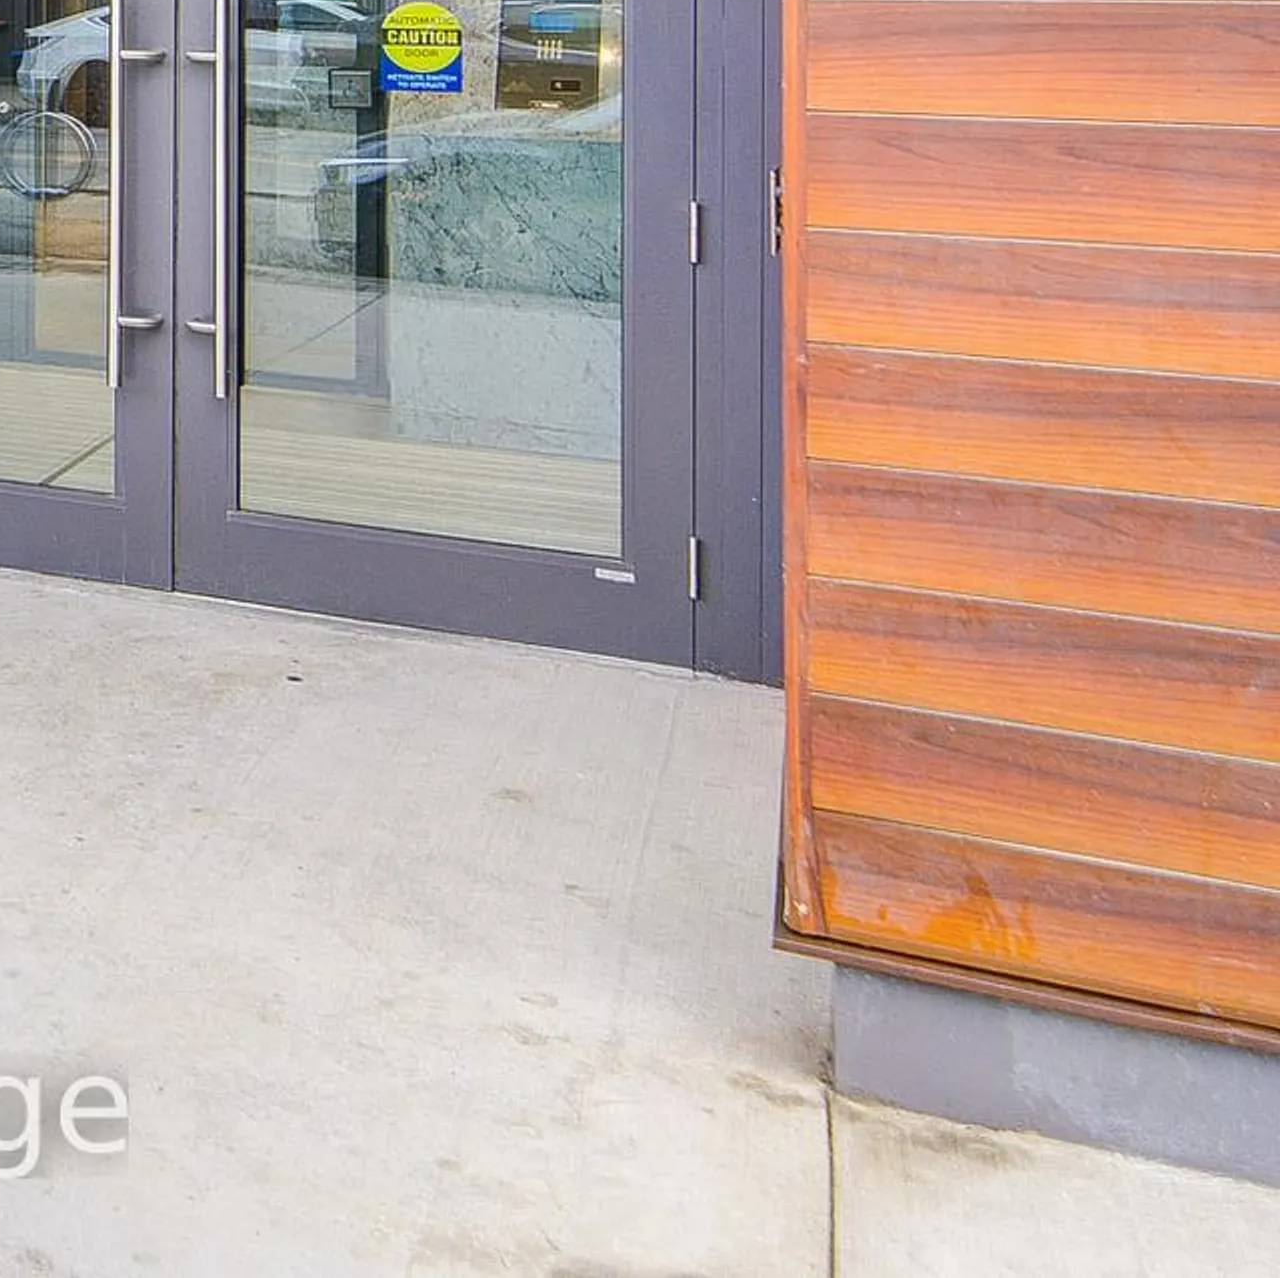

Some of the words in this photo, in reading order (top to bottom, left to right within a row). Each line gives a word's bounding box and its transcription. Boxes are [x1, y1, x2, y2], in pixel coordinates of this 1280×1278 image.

[388, 15, 456, 26] AUTOMATIC
[386, 29, 459, 45] CAUTION
[403, 48, 440, 59] DOOR
